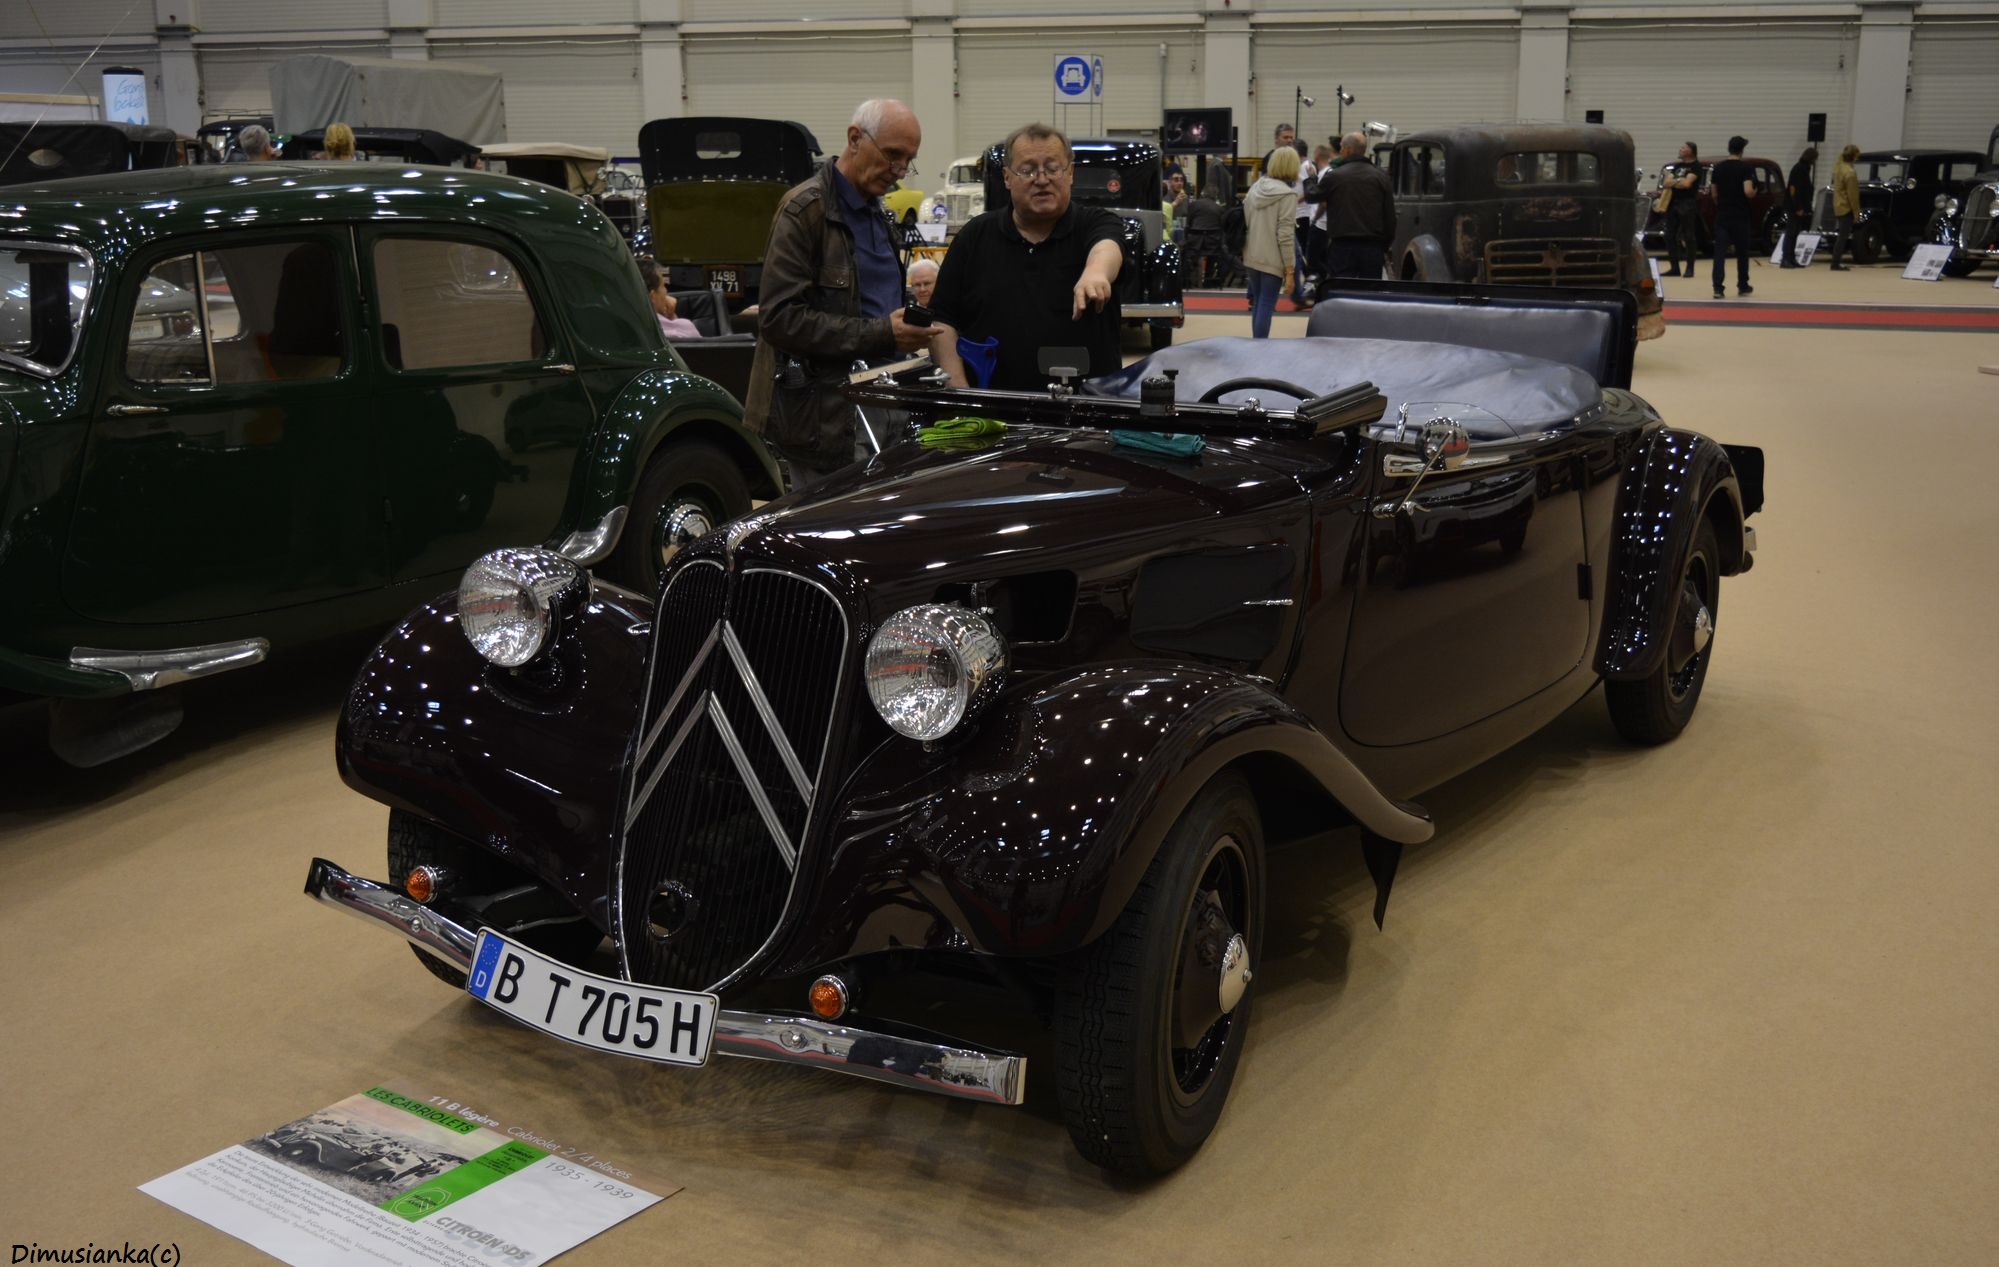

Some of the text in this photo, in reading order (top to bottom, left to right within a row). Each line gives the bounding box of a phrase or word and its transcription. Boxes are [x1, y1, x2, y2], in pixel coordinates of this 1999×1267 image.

[712, 271, 736, 281] 1498
[726, 281, 739, 292] 71
[475, 970, 487, 989] D
[493, 952, 525, 1004] B
[544, 972, 571, 1024] T
[365, 1087, 475, 1133] LES CABRIOLETS
[429, 1096, 449, 1106] 11
[446, 1102, 460, 1111] B
[458, 1107, 500, 1128] légère
[507, 1126, 561, 1151] Cabriolet
[590, 1161, 633, 1180] places
[544, 1162, 585, 1181] 1935
[593, 1181, 634, 1199] 1939
